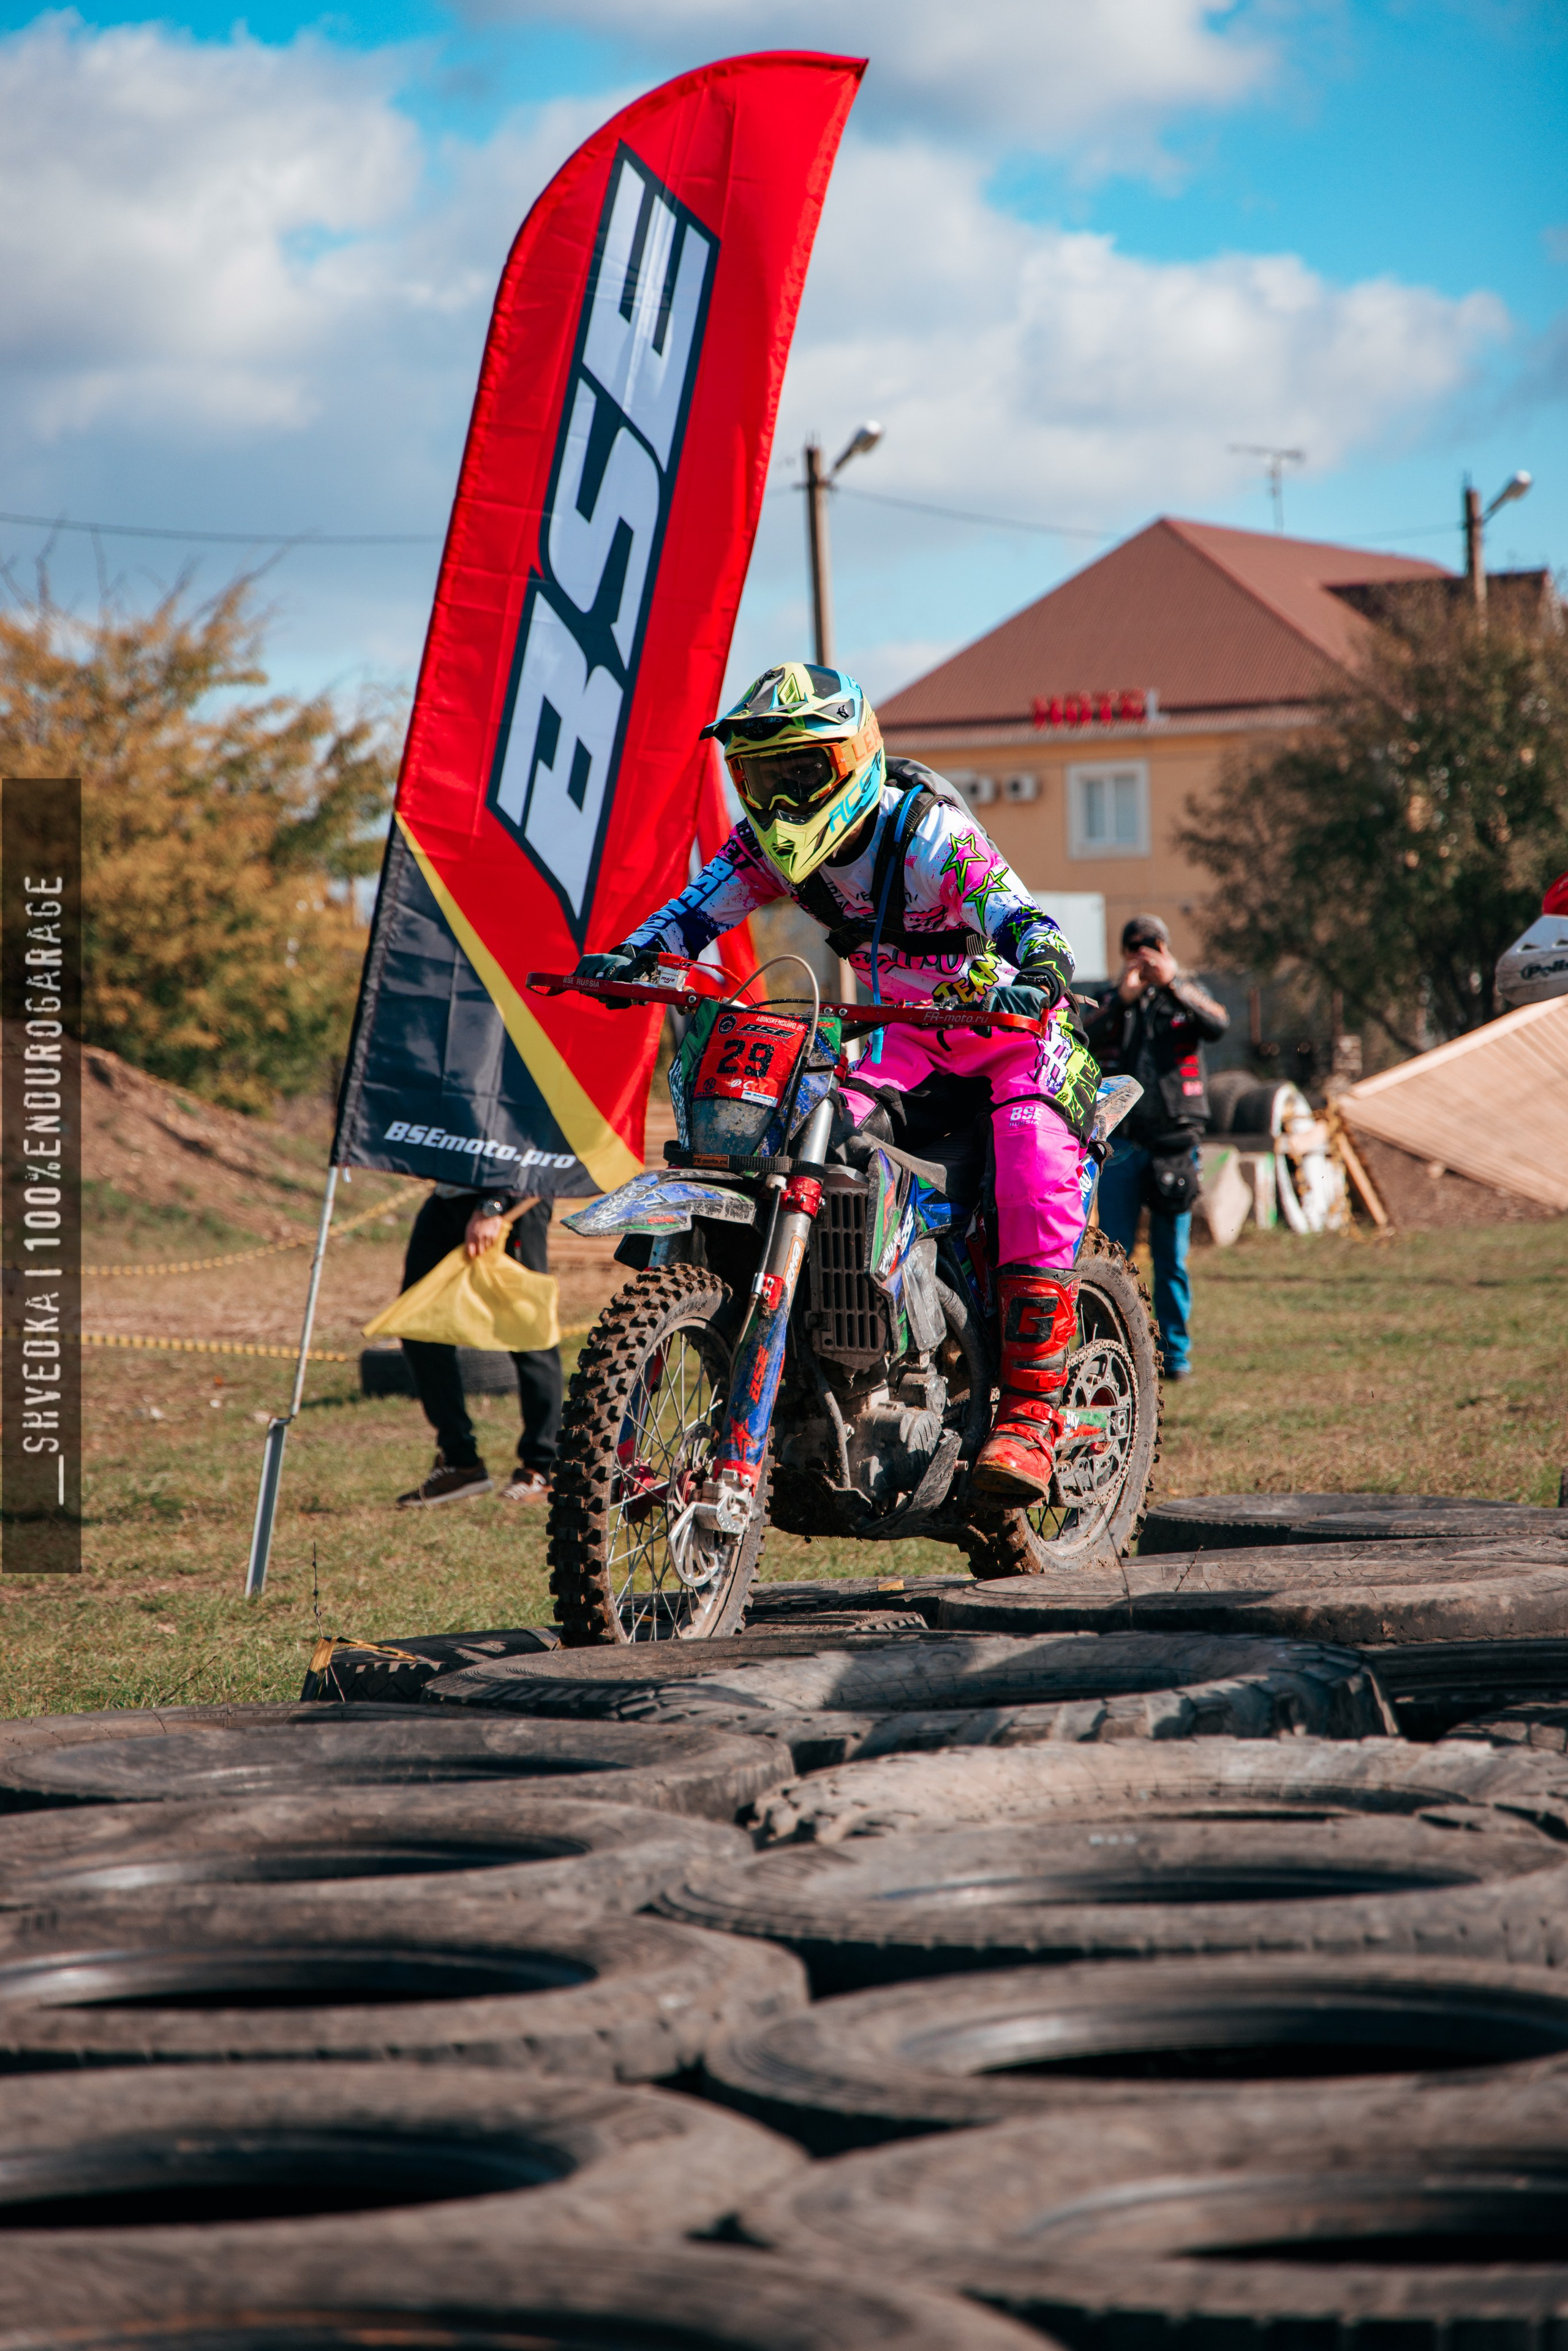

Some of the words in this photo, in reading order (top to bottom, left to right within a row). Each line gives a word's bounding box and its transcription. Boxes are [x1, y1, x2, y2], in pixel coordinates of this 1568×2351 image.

[494, 156, 712, 923] BSE
[576, 978, 600, 988] RUSSIA
[933, 951, 1001, 1003] TEAM
[923, 1011, 989, 1024] FR-moto.ru
[716, 1039, 775, 1079] 29
[1008, 1119, 1040, 1128] RUSSIA
[1010, 1106, 1044, 1122] BSE
[383, 1120, 578, 1169] BSEmoto.pro
[748, 1345, 770, 1405] BSE
